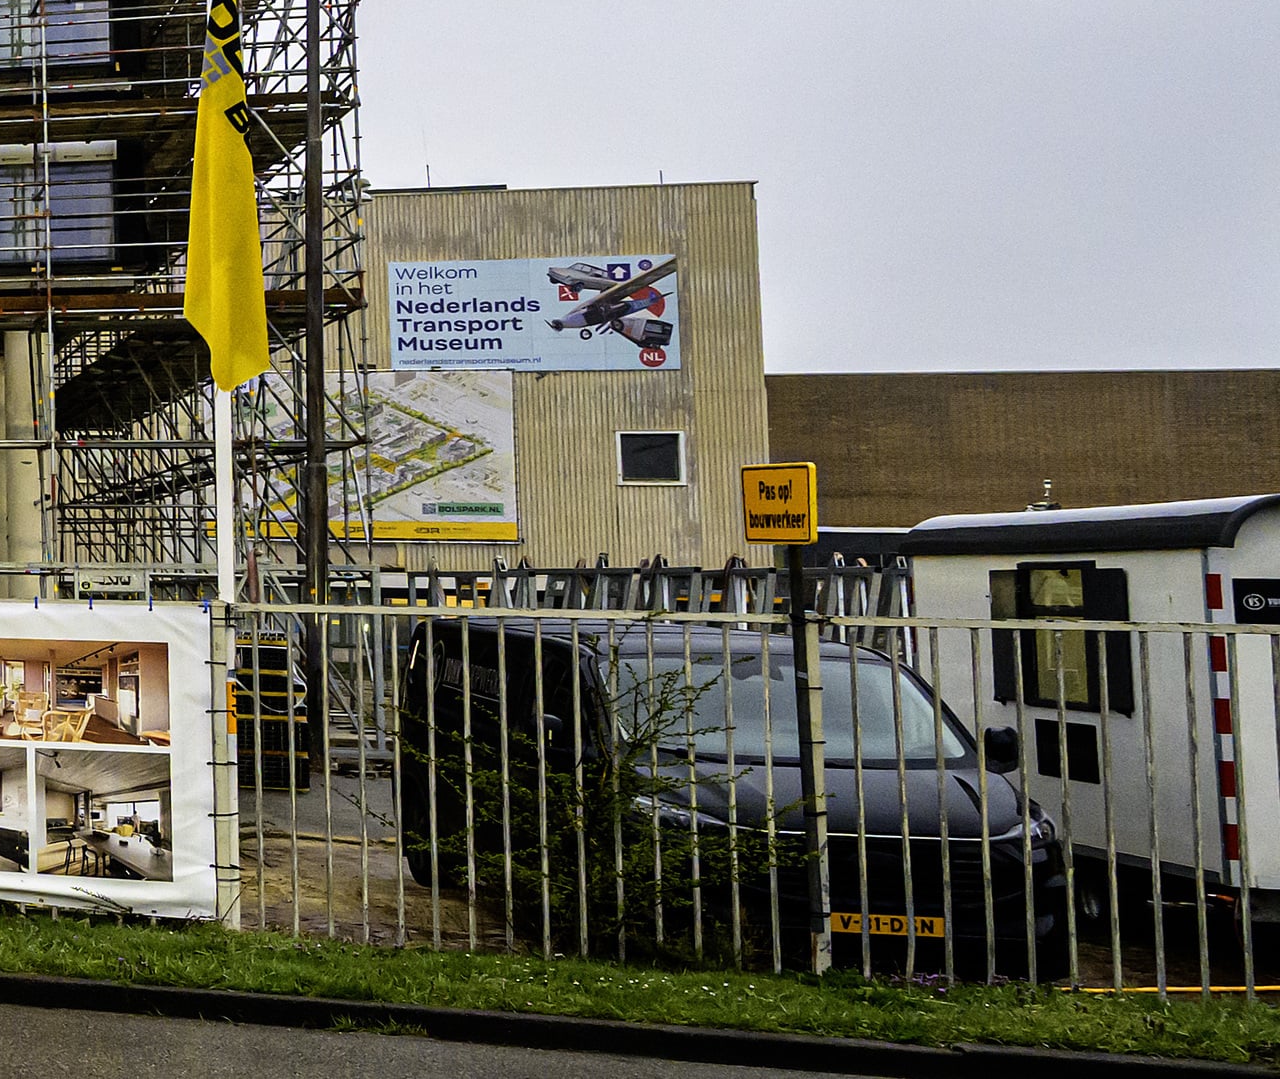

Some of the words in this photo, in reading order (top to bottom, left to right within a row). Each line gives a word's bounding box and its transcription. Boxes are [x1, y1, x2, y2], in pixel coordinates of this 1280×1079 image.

[395, 266, 478, 280] Welkom
[396, 282, 413, 295] in
[418, 281, 453, 295] het
[396, 297, 541, 314] Nederlands
[397, 317, 523, 334] Transport
[397, 336, 503, 351] Museum
[643, 352, 664, 361] NL
[758, 481, 776, 500] Pas
[778, 480, 792, 504] op!
[438, 504, 501, 514] BOLSPARK.NL
[749, 509, 806, 528] bouwverkeer
